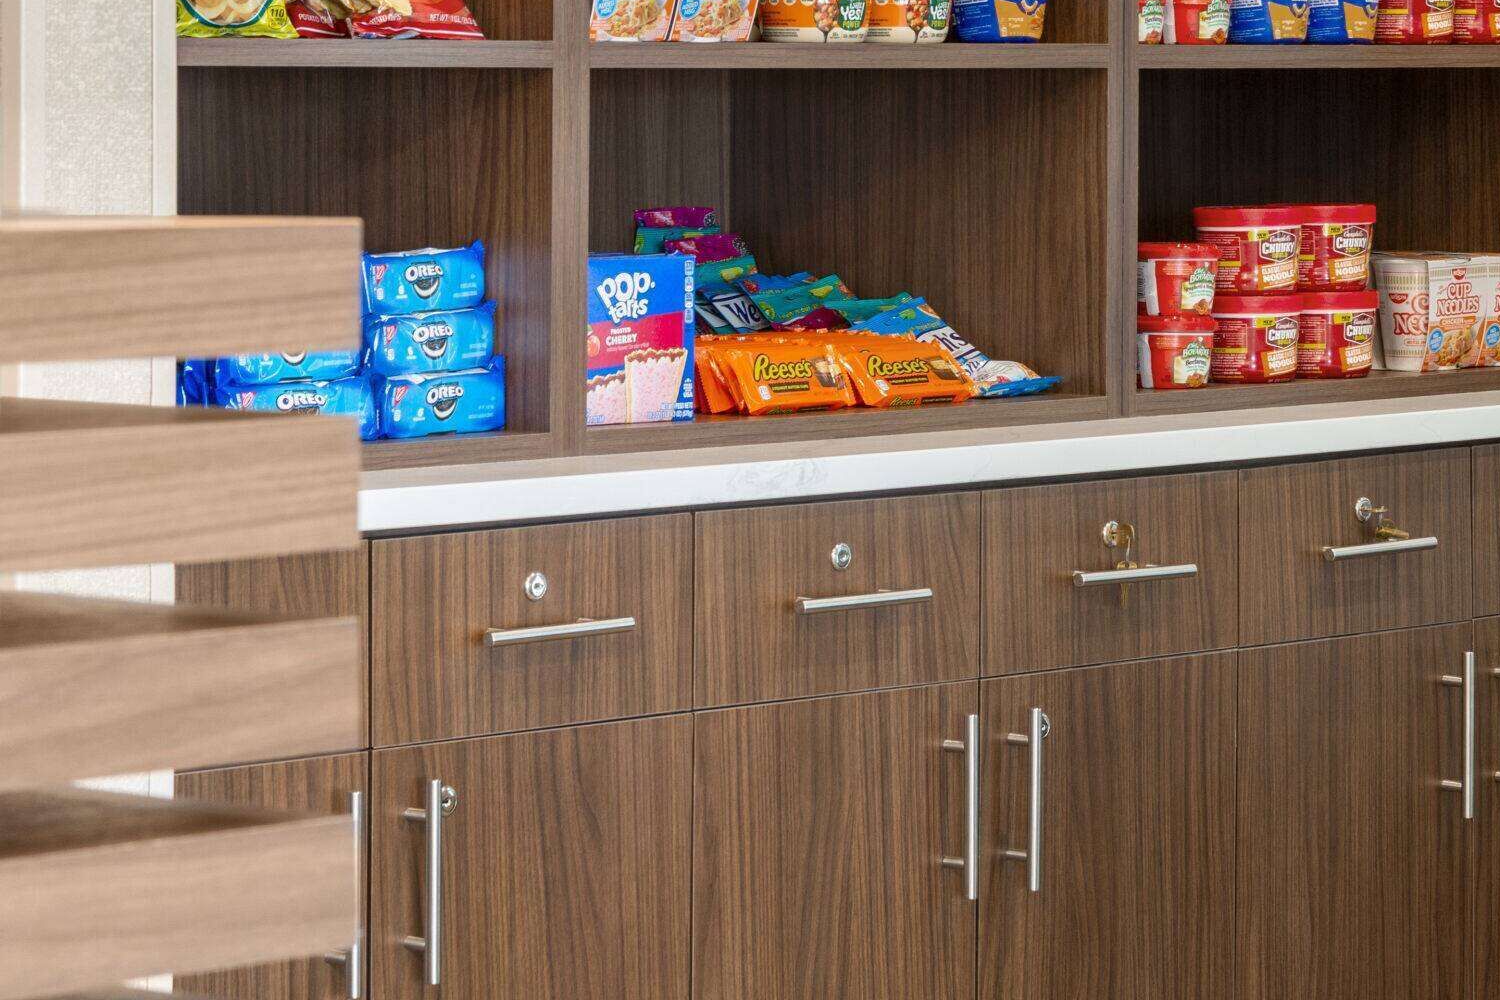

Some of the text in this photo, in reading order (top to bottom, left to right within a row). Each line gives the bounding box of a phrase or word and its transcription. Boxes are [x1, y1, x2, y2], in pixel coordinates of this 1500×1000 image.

[270, 8, 285, 18] 110
[840, 2, 865, 20] Yes!
[931, 2, 950, 19] Yes!
[1262, 241, 1295, 254] CHUNKY
[1335, 237, 1367, 248] CHUNKY
[404, 264, 444, 282] OREO
[1263, 270, 1295, 283] NOODLE
[1447, 281, 1473, 299] CUP
[1436, 296, 1480, 317] NOODLES
[412, 324, 454, 343] OREO
[605, 333, 638, 346] CHERRY
[1268, 328, 1298, 341] CHUNKY
[754, 353, 813, 382] Reese's
[867, 355, 930, 377] Reese's
[1268, 357, 1296, 370] NOODLE
[276, 389, 327, 410] OREO
[426, 385, 464, 405] OREO
